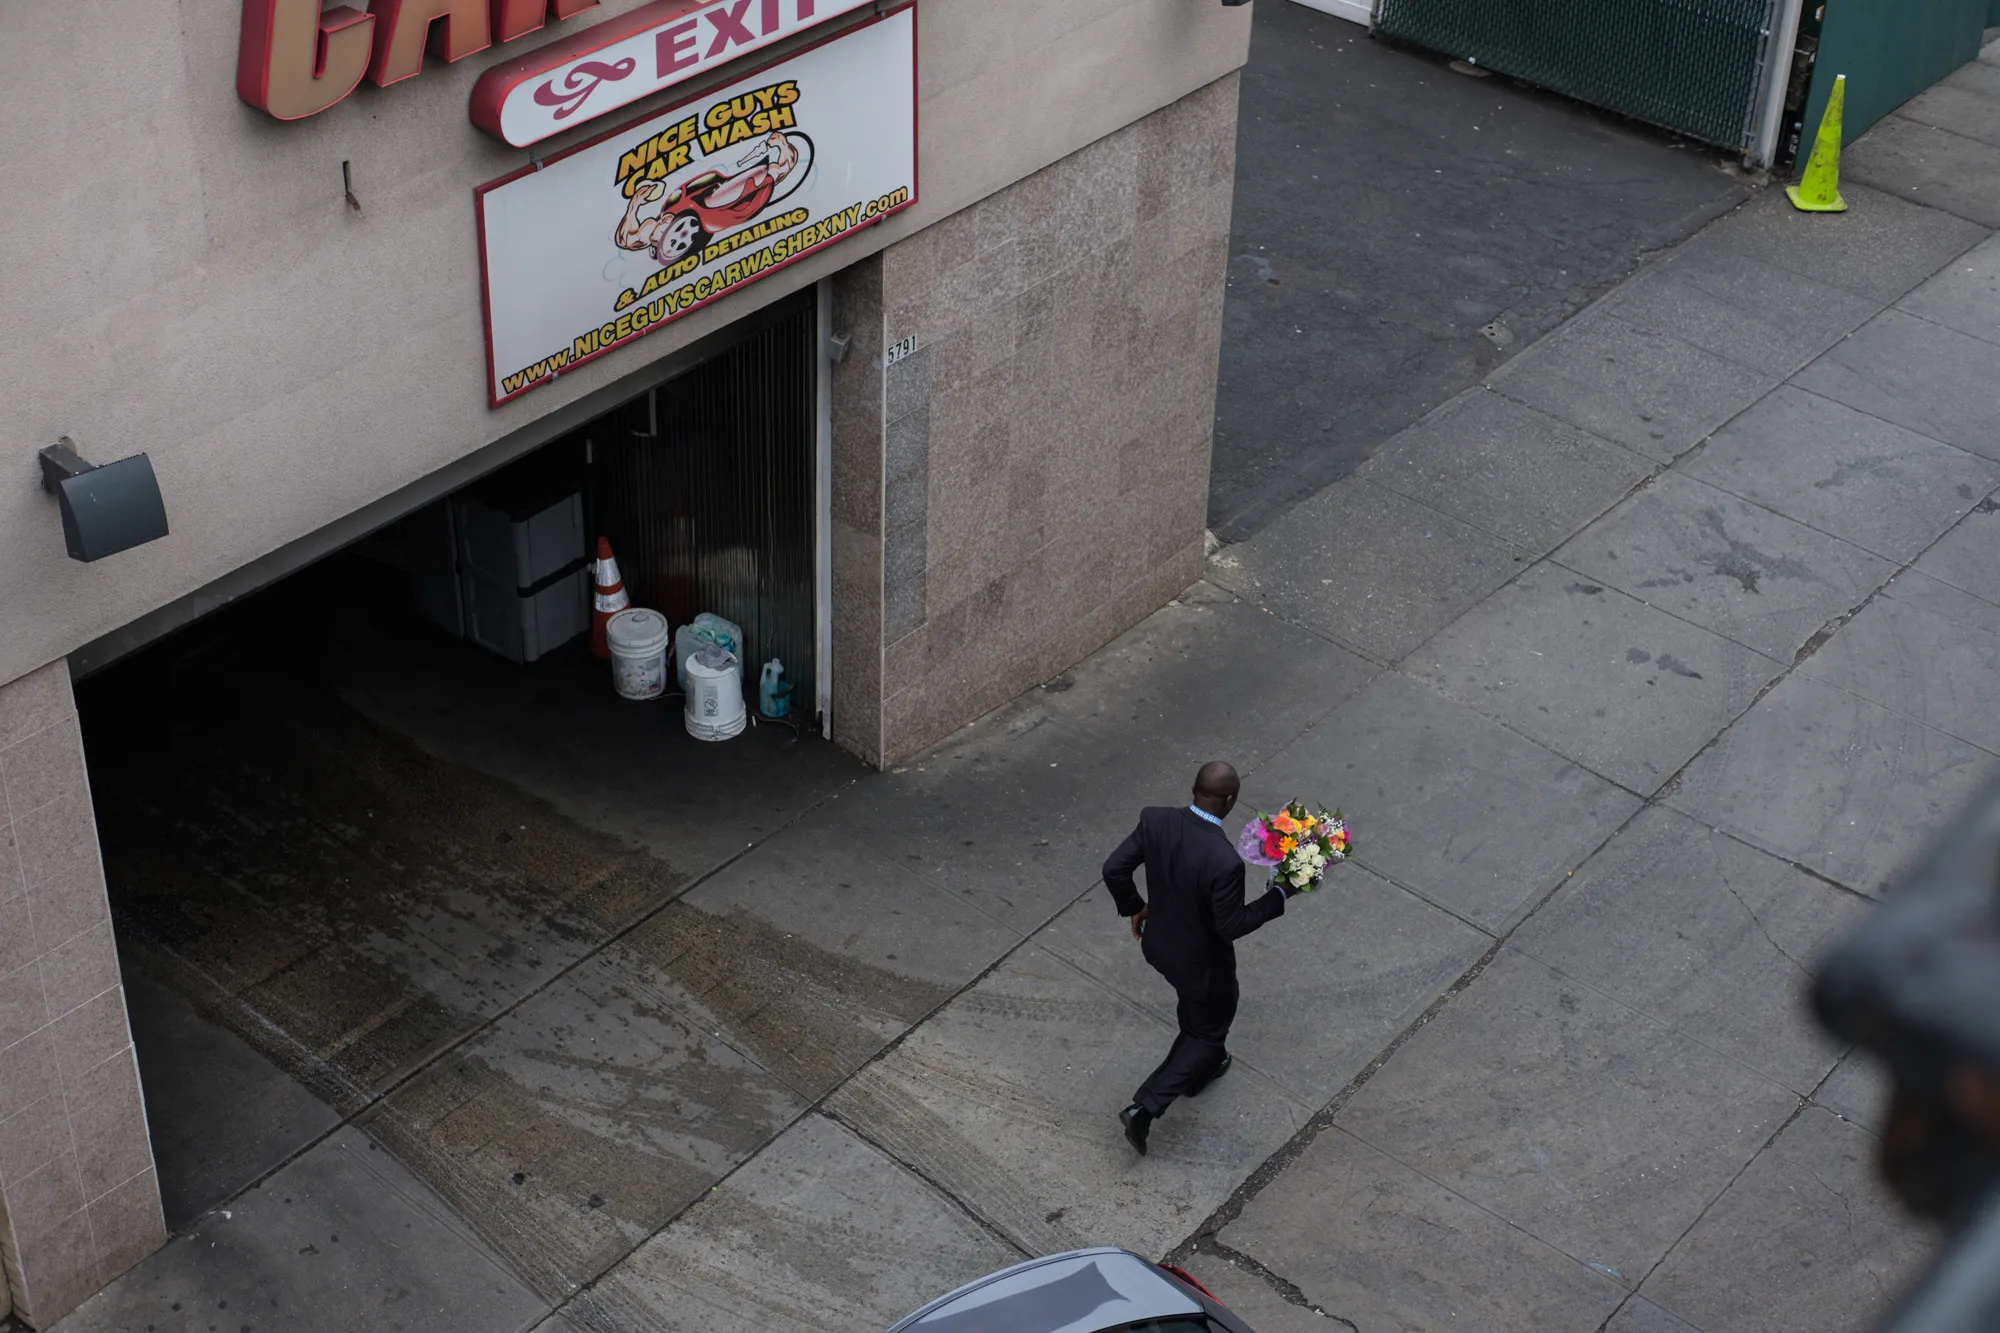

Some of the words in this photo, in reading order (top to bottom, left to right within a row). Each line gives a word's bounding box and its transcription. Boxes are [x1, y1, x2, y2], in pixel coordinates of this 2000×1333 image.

[615, 114, 699, 186] NICE
[704, 80, 800, 130] GUYS
[622, 142, 695, 198] CAR
[698, 105, 797, 156] WASH
[502, 186, 908, 394] www.NICEGUYSCARWASHBXNY.com
[614, 287, 638, 312] &
[641, 256, 699, 297] AUTO
[702, 207, 809, 265] DETAILING
[887, 335, 917, 363] 5791
